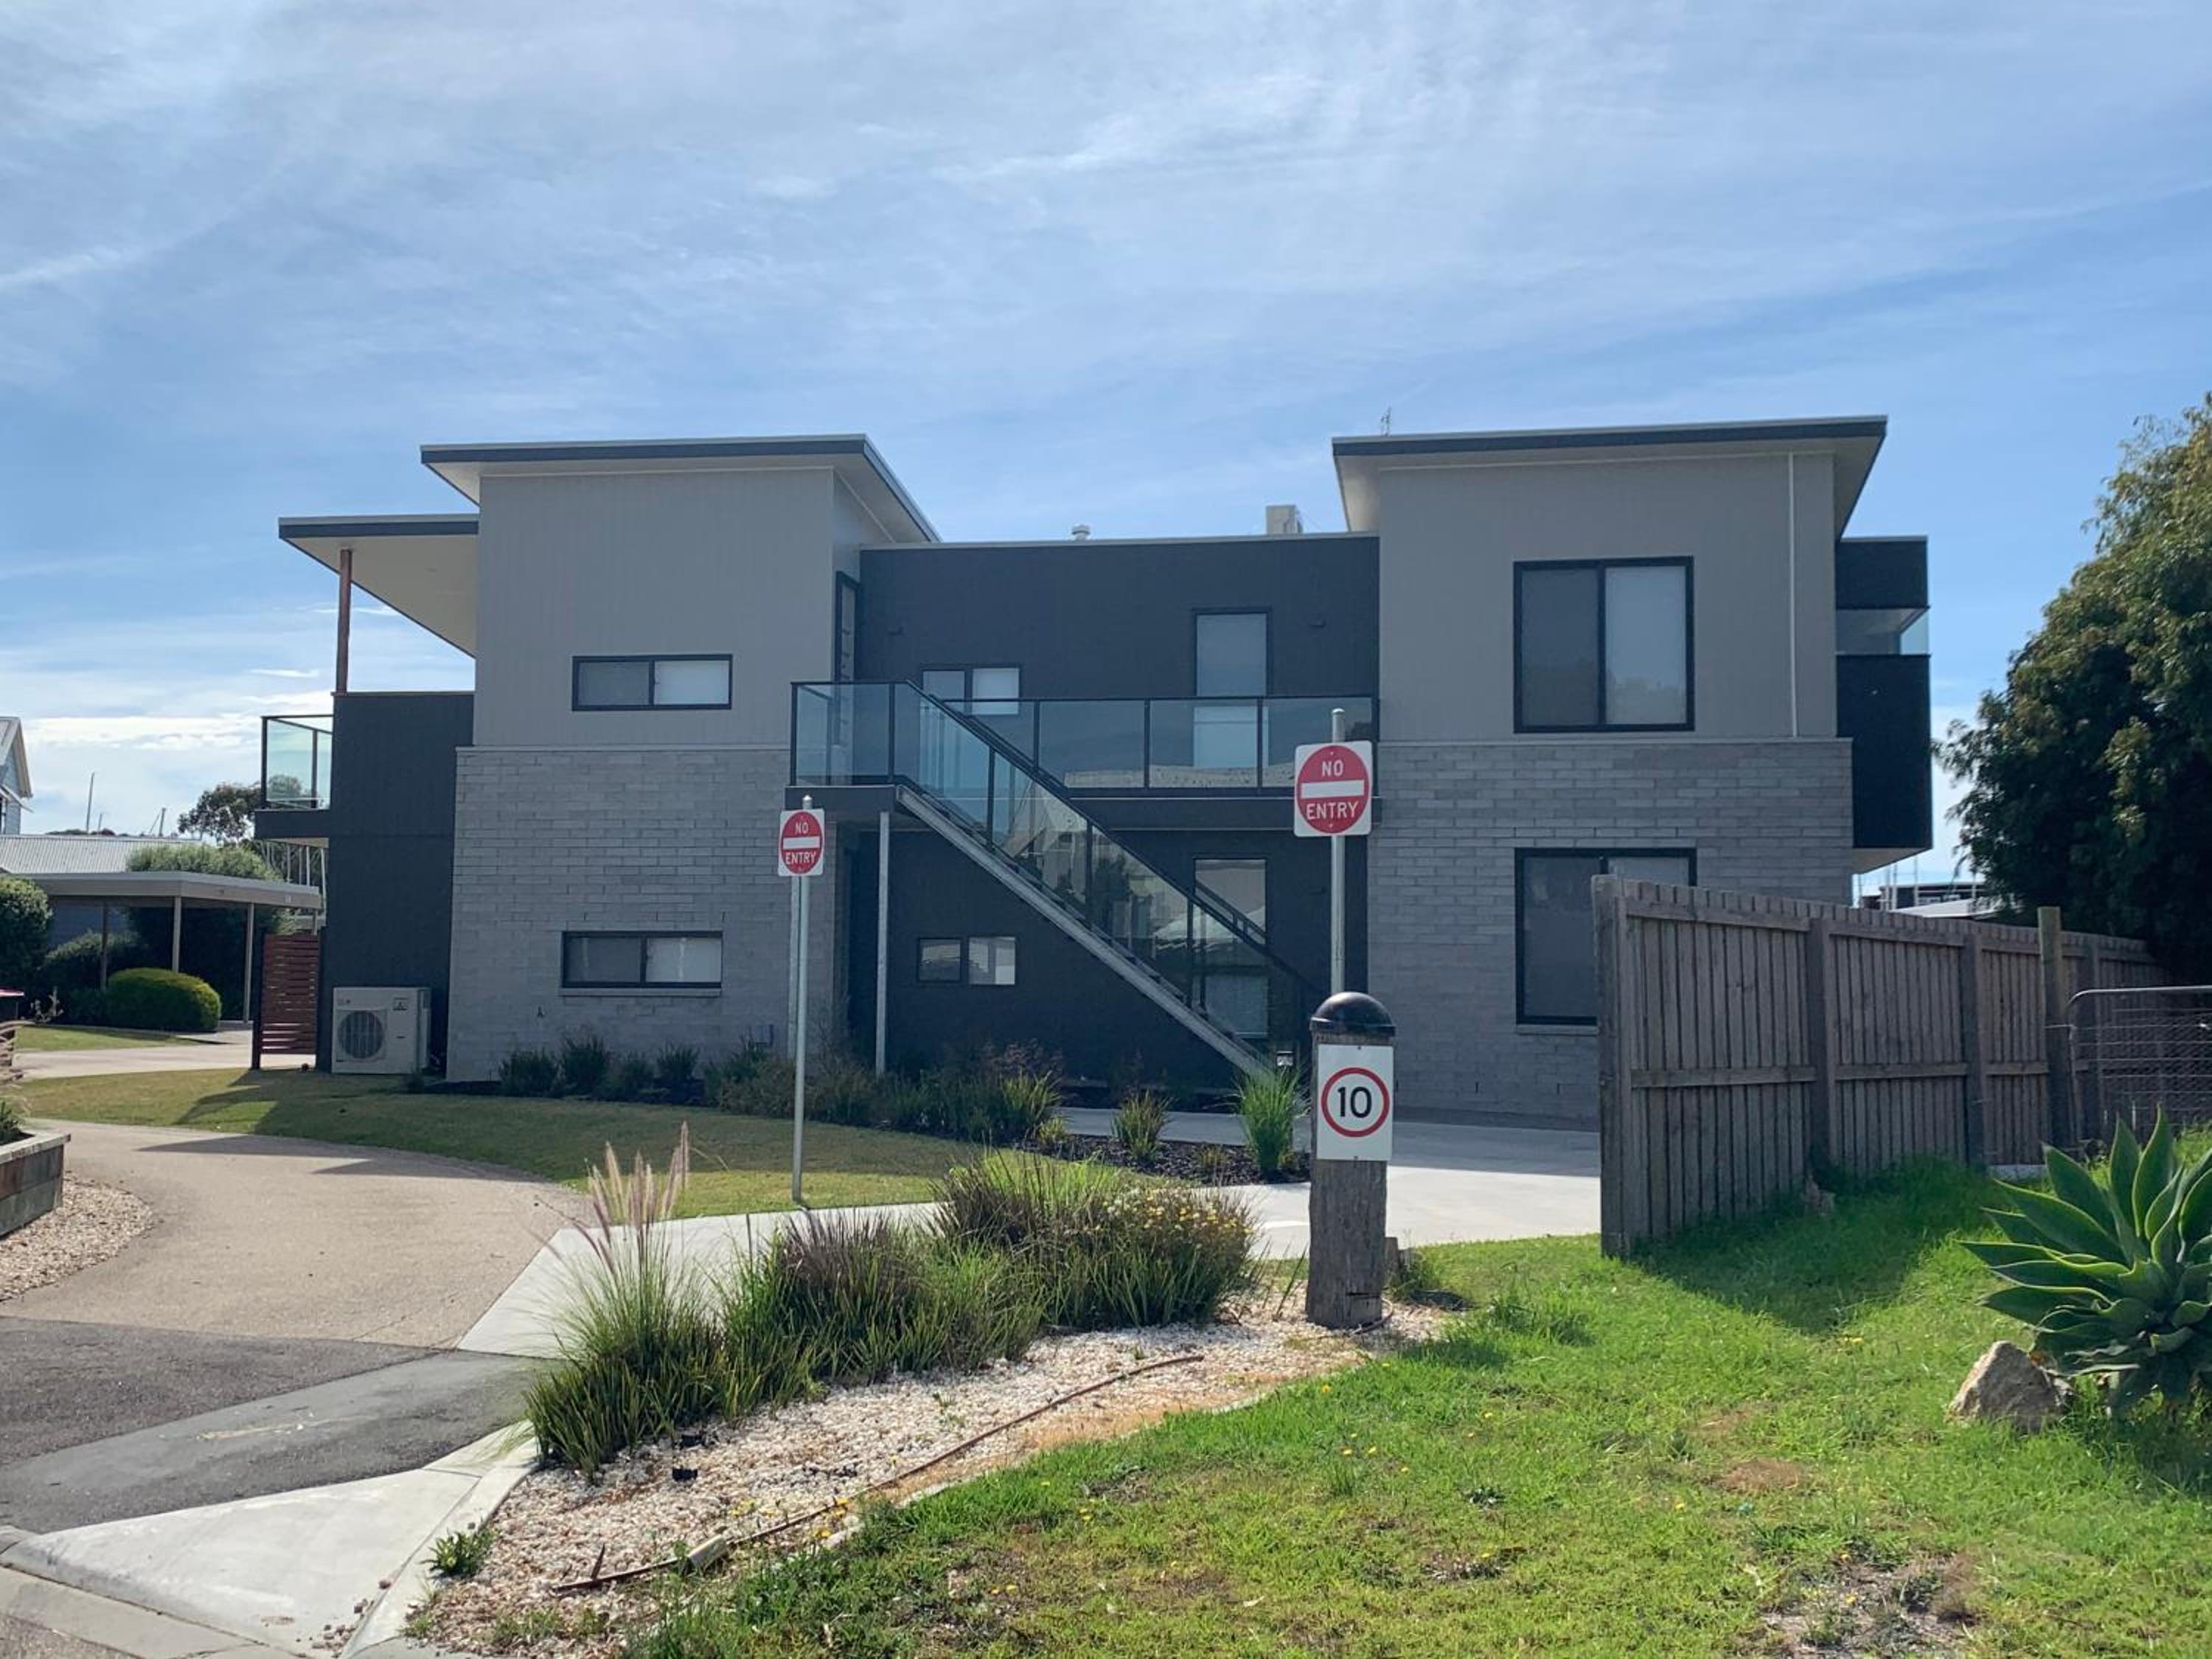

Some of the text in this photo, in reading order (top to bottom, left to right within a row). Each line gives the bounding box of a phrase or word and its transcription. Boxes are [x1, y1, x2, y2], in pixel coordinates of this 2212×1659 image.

[1321, 759, 1344, 777] NO
[1306, 801, 1359, 820] ENTRY
[795, 822, 809, 835] NO
[785, 851, 816, 865] ENTRY
[1337, 1087, 1372, 1118] 10
